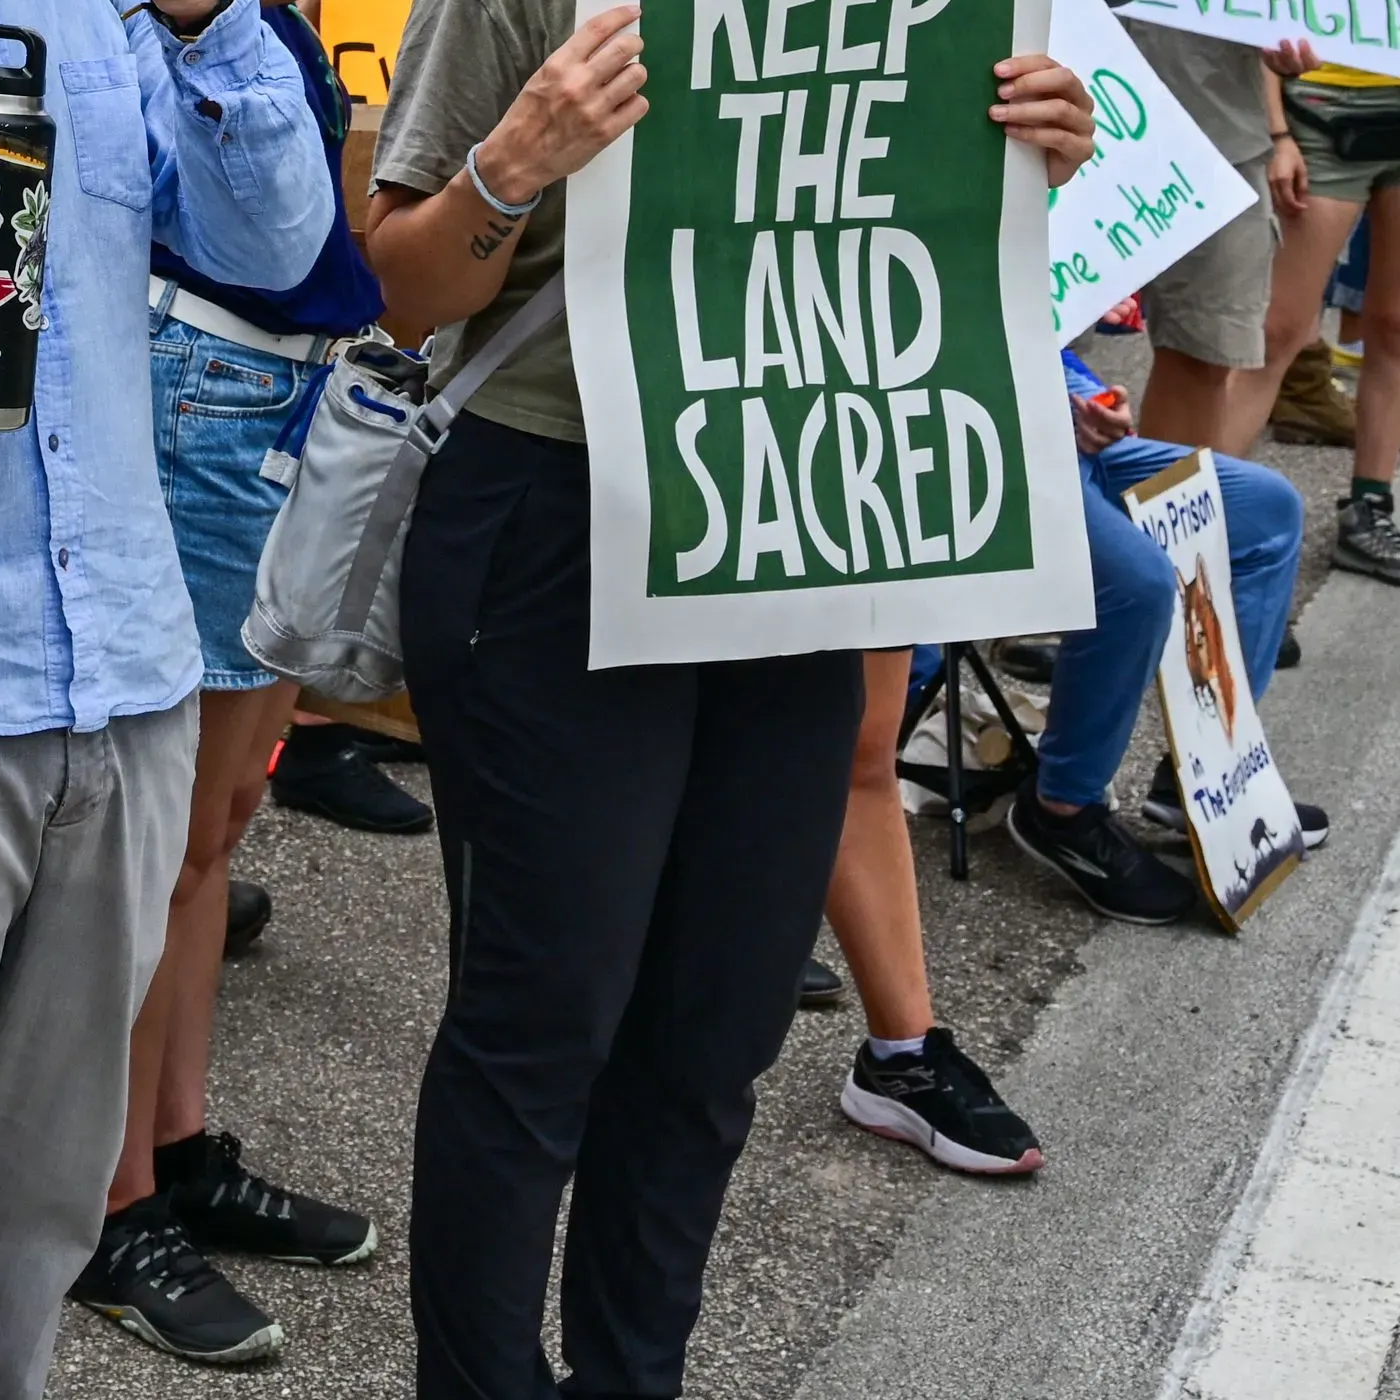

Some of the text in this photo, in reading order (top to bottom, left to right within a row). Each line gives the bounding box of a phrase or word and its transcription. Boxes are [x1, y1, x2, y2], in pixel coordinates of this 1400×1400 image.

[718, 80, 908, 225] THE
[1093, 218, 1143, 261] in
[1116, 159, 1206, 239] them!
[671, 226, 941, 392] LAND
[675, 388, 1003, 584] SACRED
[1142, 489, 1217, 552] No Prison
[1188, 751, 1205, 780] in
[1193, 741, 1270, 823] The Everglades
